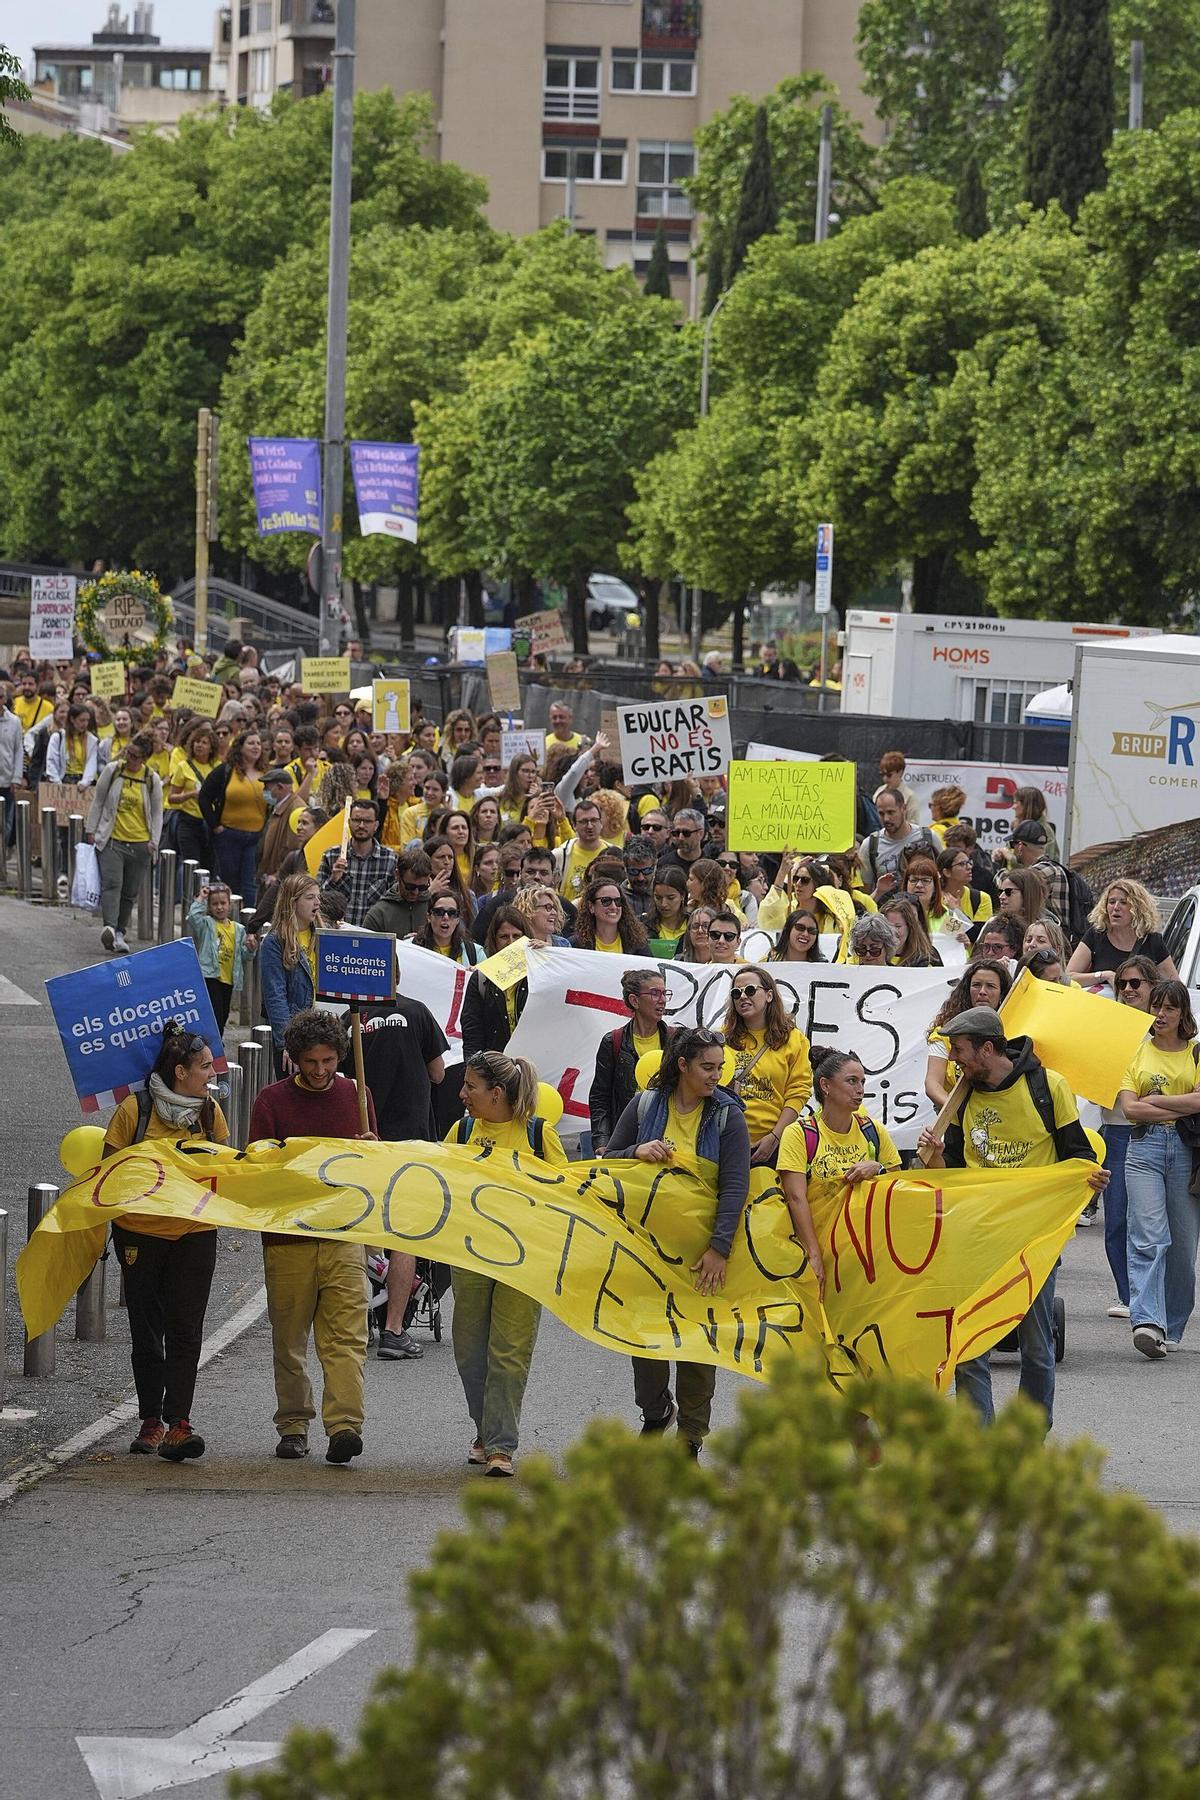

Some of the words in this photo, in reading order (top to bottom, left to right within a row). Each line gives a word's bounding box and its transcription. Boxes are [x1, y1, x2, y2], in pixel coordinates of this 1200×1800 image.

[114, 597, 136, 616] RIP
[932, 646, 990, 664] HOMS
[624, 704, 708, 734] EDUCAR
[649, 733, 679, 754] NO
[1121, 736, 1163, 754] GRUP
[631, 746, 721, 778] GRATIS
[817, 767, 845, 782] TAN
[733, 804, 752, 820] LA
[325, 953, 340, 962] els
[342, 955, 386, 967] docents
[326, 964, 338, 973] es
[340, 966, 385, 977] quadren
[71, 1016, 104, 1037] els
[108, 988, 197, 1027] docents
[79, 1036, 106, 1055] es
